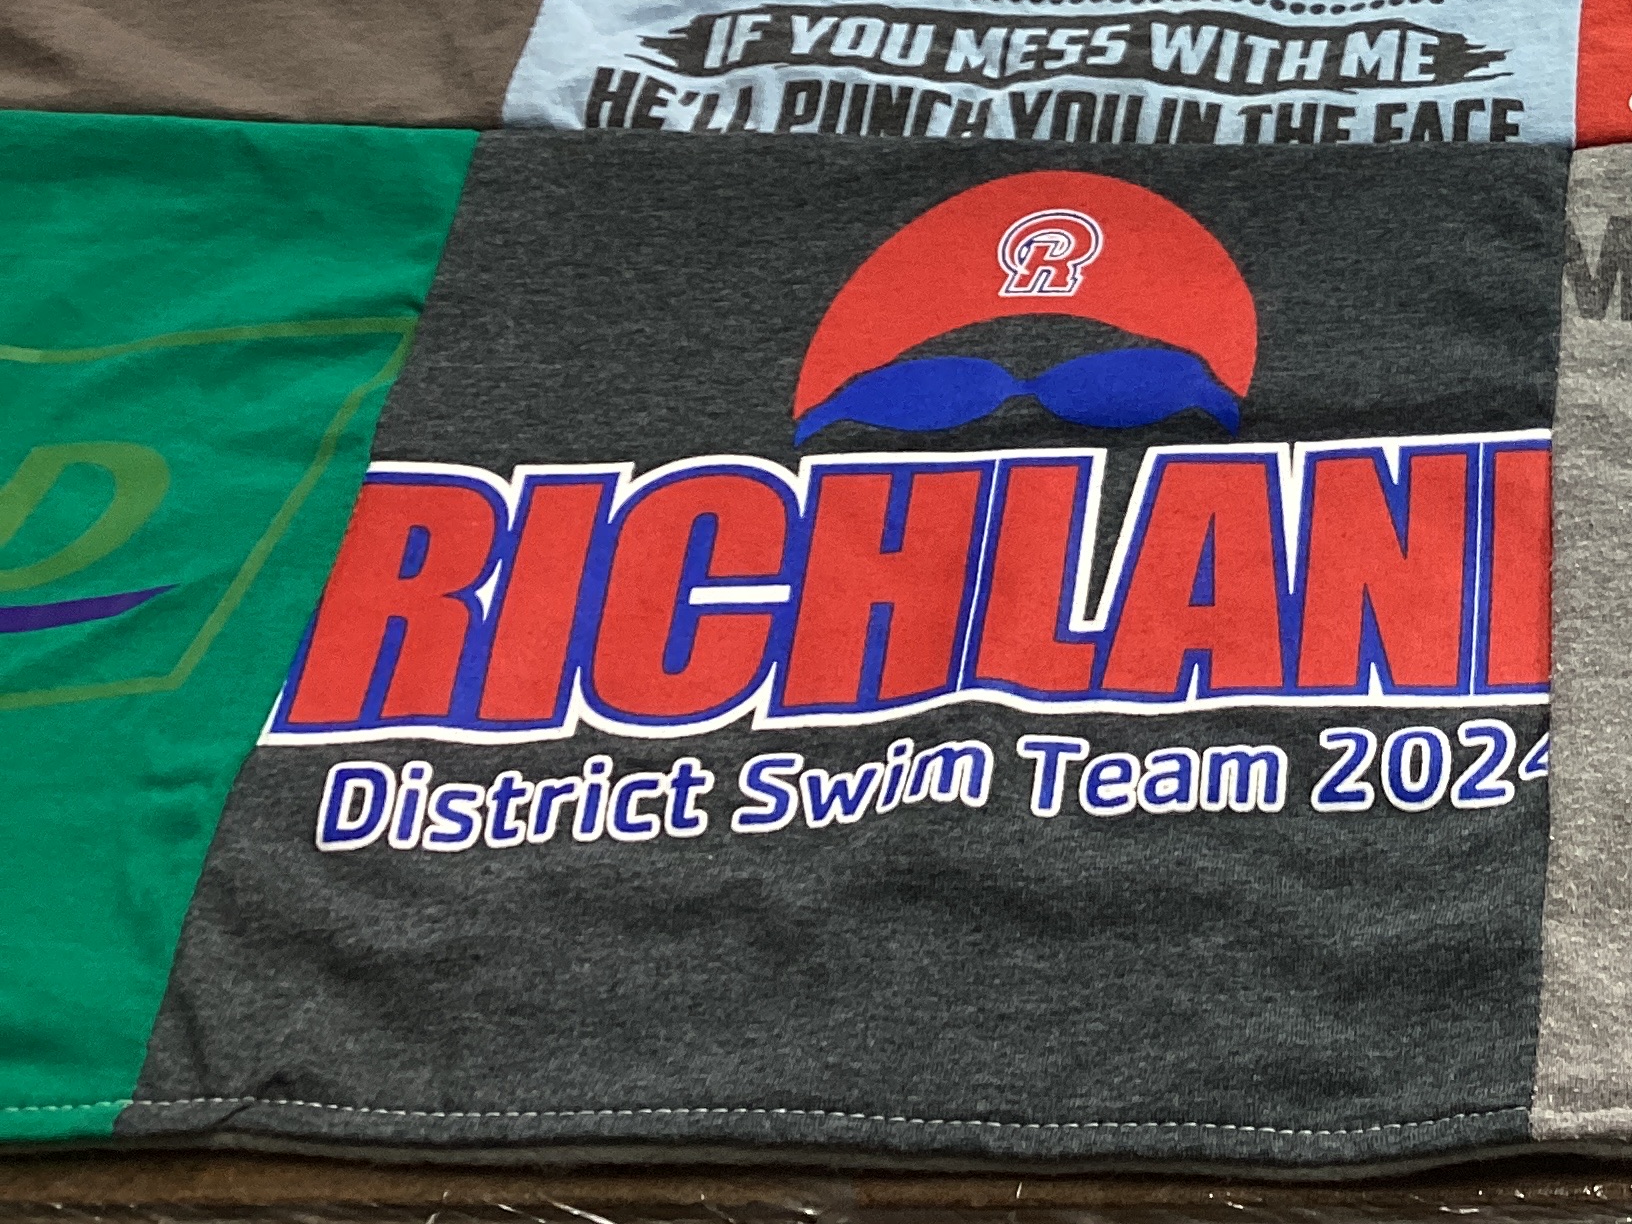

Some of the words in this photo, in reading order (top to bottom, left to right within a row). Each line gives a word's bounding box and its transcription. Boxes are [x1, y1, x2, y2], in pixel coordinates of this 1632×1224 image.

[703, 13, 772, 70] IF
[789, 15, 937, 69] YOU
[944, 23, 1132, 79] MESS
[1149, 22, 1328, 85] WITH
[1339, 28, 1440, 84] ME
[1238, 101, 1357, 144] THE
[1372, 98, 1526, 144] FACE
[998, 208, 1104, 297] R
[317, 755, 709, 852] District
[730, 739, 995, 833] Swim
[1017, 733, 1288, 817] Team
